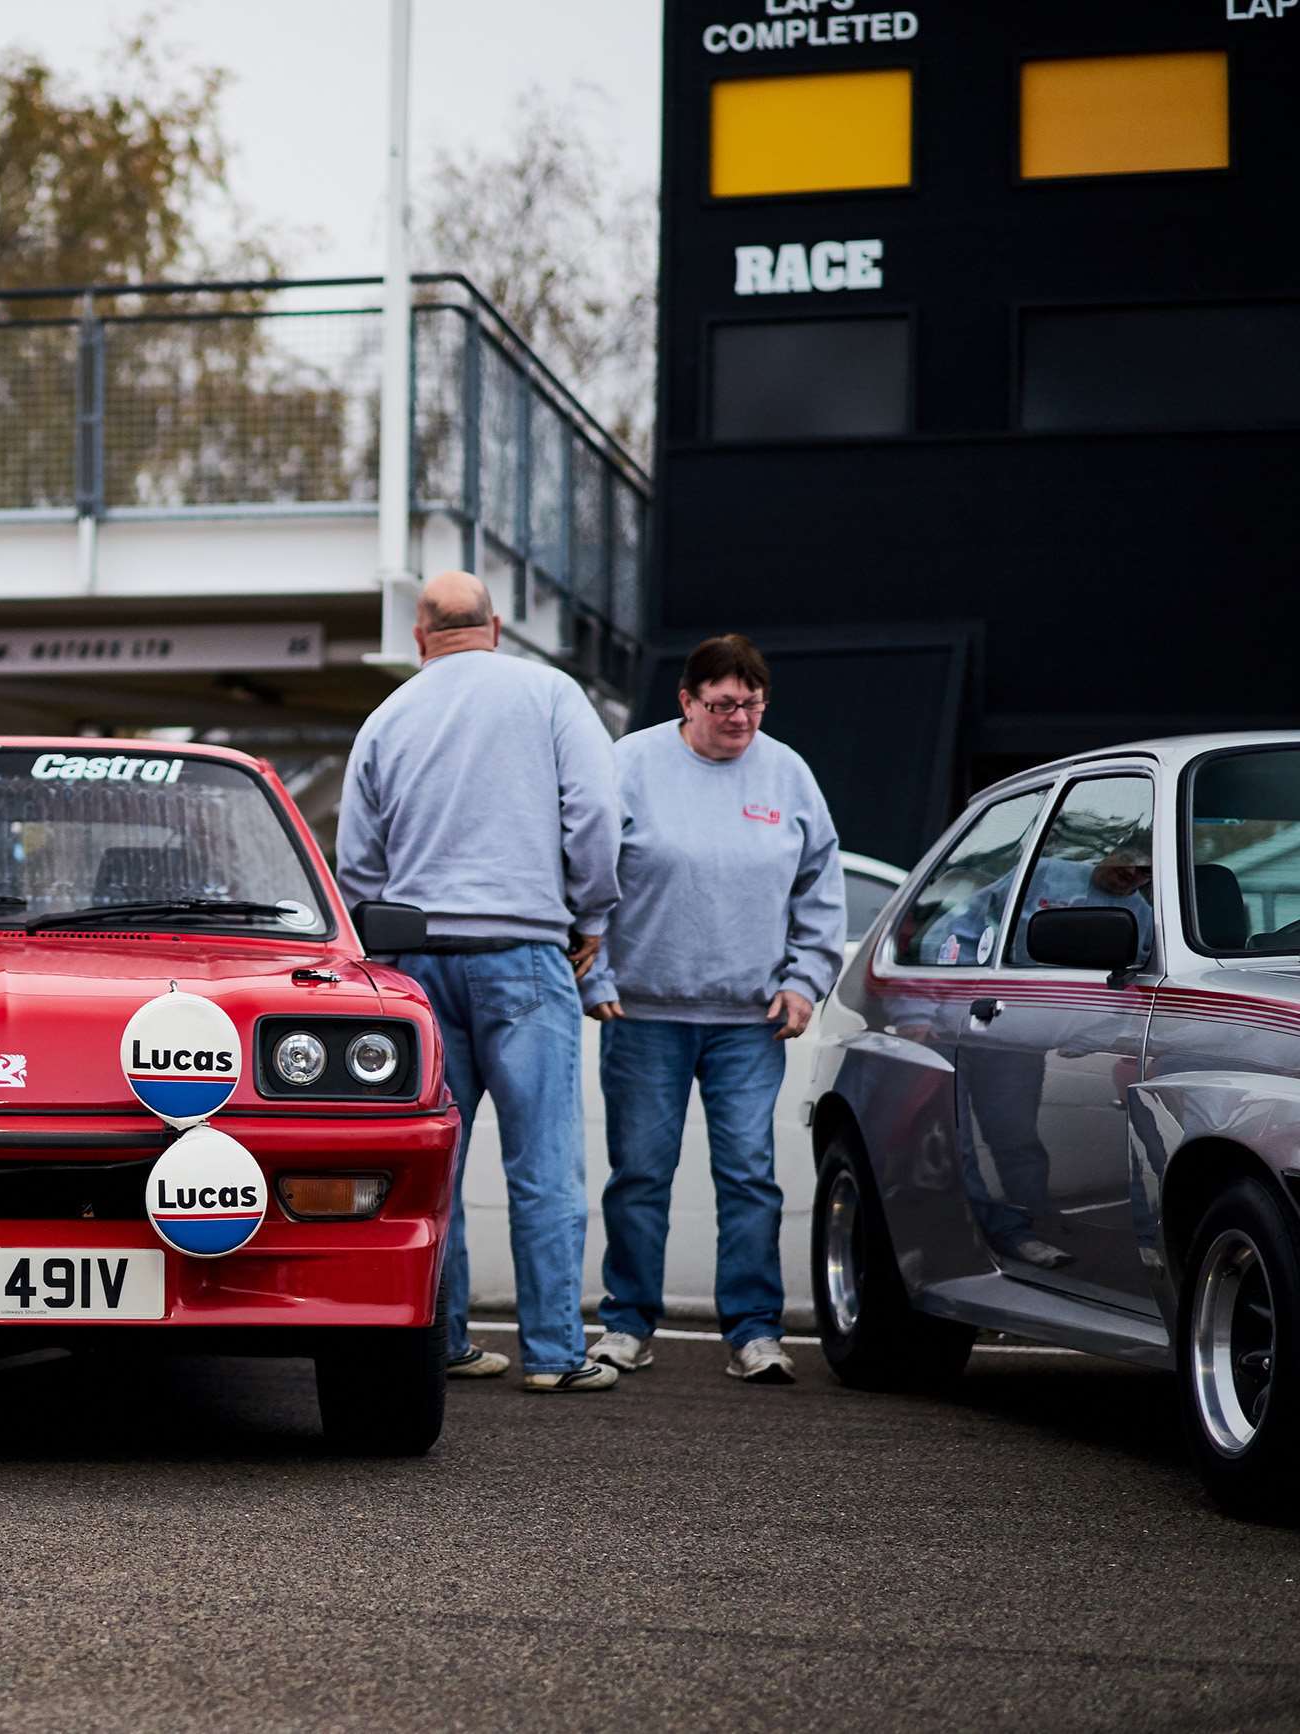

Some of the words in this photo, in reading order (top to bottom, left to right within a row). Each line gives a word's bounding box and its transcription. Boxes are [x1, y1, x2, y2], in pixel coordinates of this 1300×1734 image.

[703, 11, 919, 53] COMPLETED
[734, 239, 882, 294] RACE
[31, 753, 184, 783] Castrol
[132, 1040, 233, 1072] Lucas
[158, 1180, 257, 1209] Lucas
[4, 1257, 129, 1309] 491V
